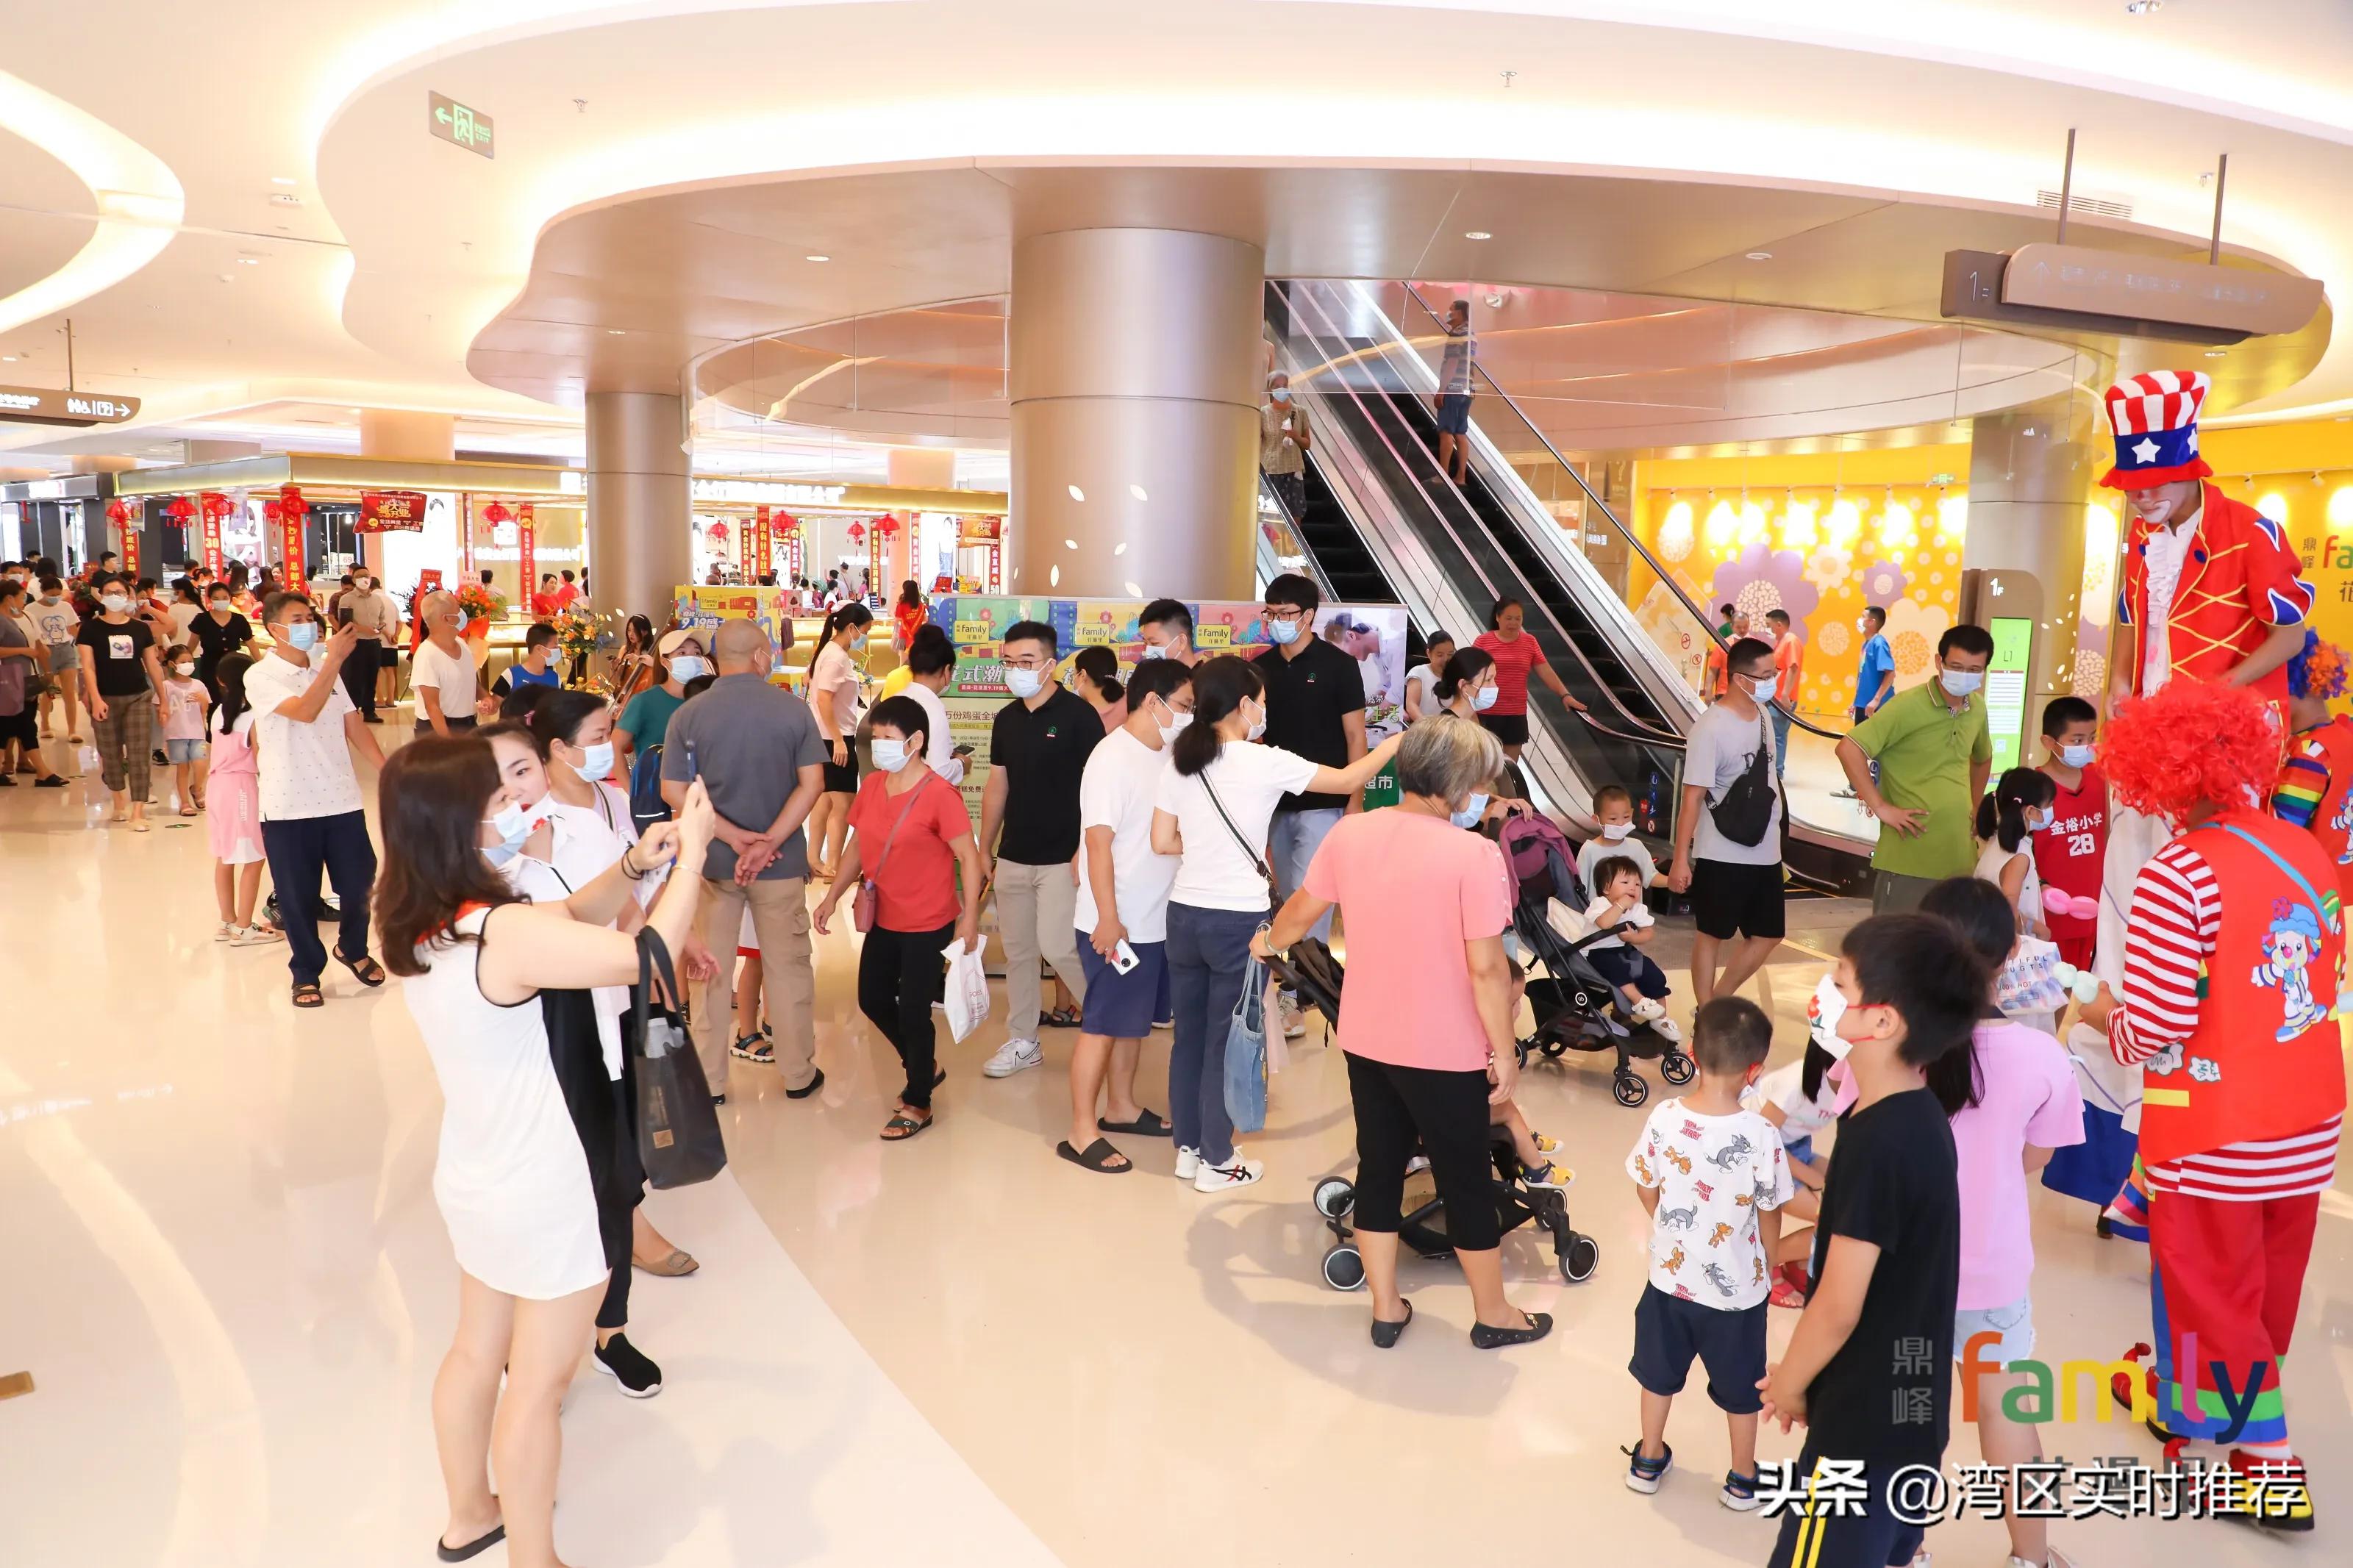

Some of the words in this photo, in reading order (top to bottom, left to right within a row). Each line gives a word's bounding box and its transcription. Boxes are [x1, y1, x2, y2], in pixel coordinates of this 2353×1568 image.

[205, 537, 219, 548] 30
[1990, 577, 2004, 596] 1F
[962, 624, 987, 634] family
[1082, 627, 1107, 637] family
[1203, 629, 1229, 639] family
[2049, 812, 2102, 835] 金裕小学
[2067, 833, 2096, 856] 28
[1684, 1119, 1697, 1130] TOM
[1679, 1127, 1702, 1141] JERRY
